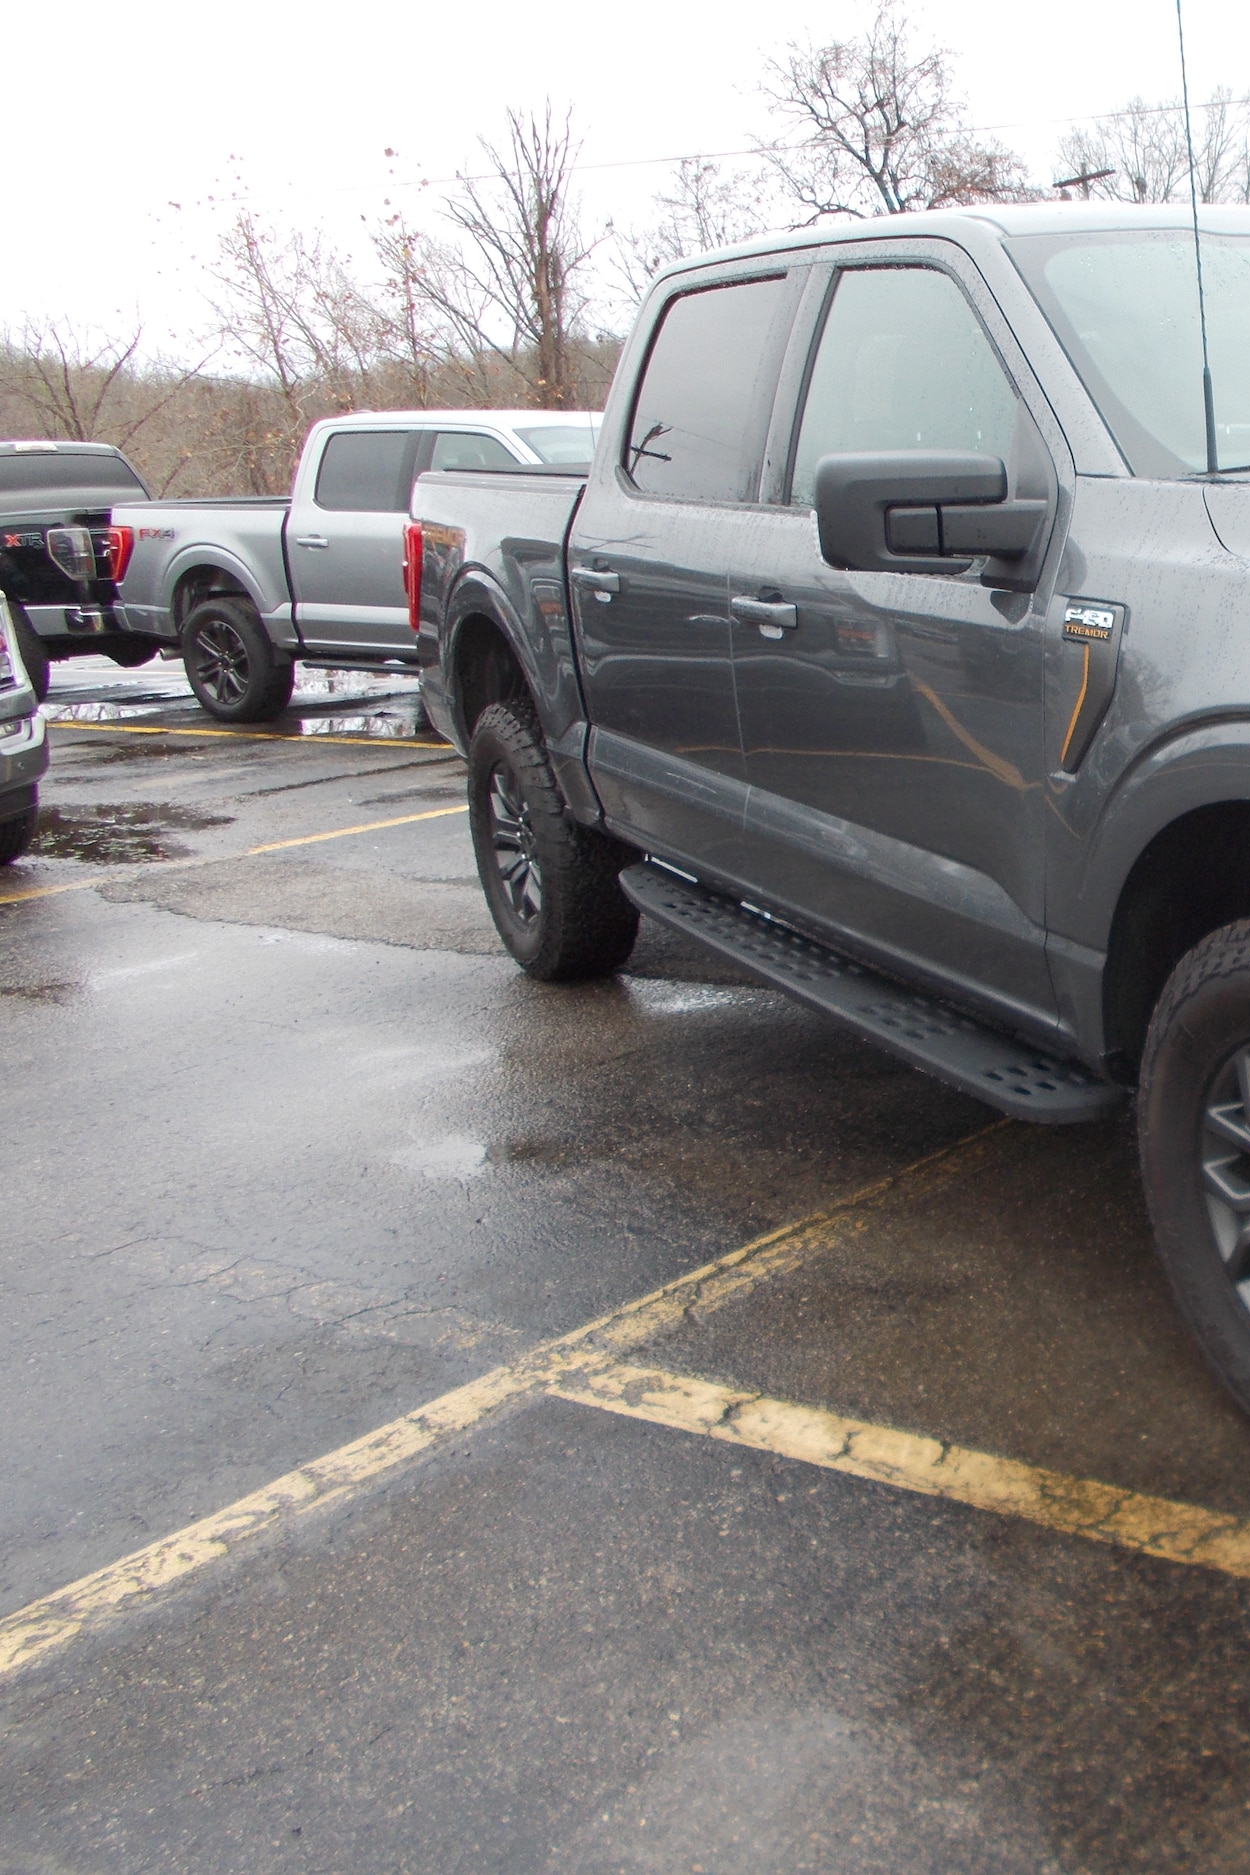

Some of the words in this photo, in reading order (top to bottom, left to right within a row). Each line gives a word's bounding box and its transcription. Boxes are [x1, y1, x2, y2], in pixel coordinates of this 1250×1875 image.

[5, 532, 45, 547] XTR
[138, 528, 176, 541] FX4
[1064, 624, 1109, 639] TREMOR
